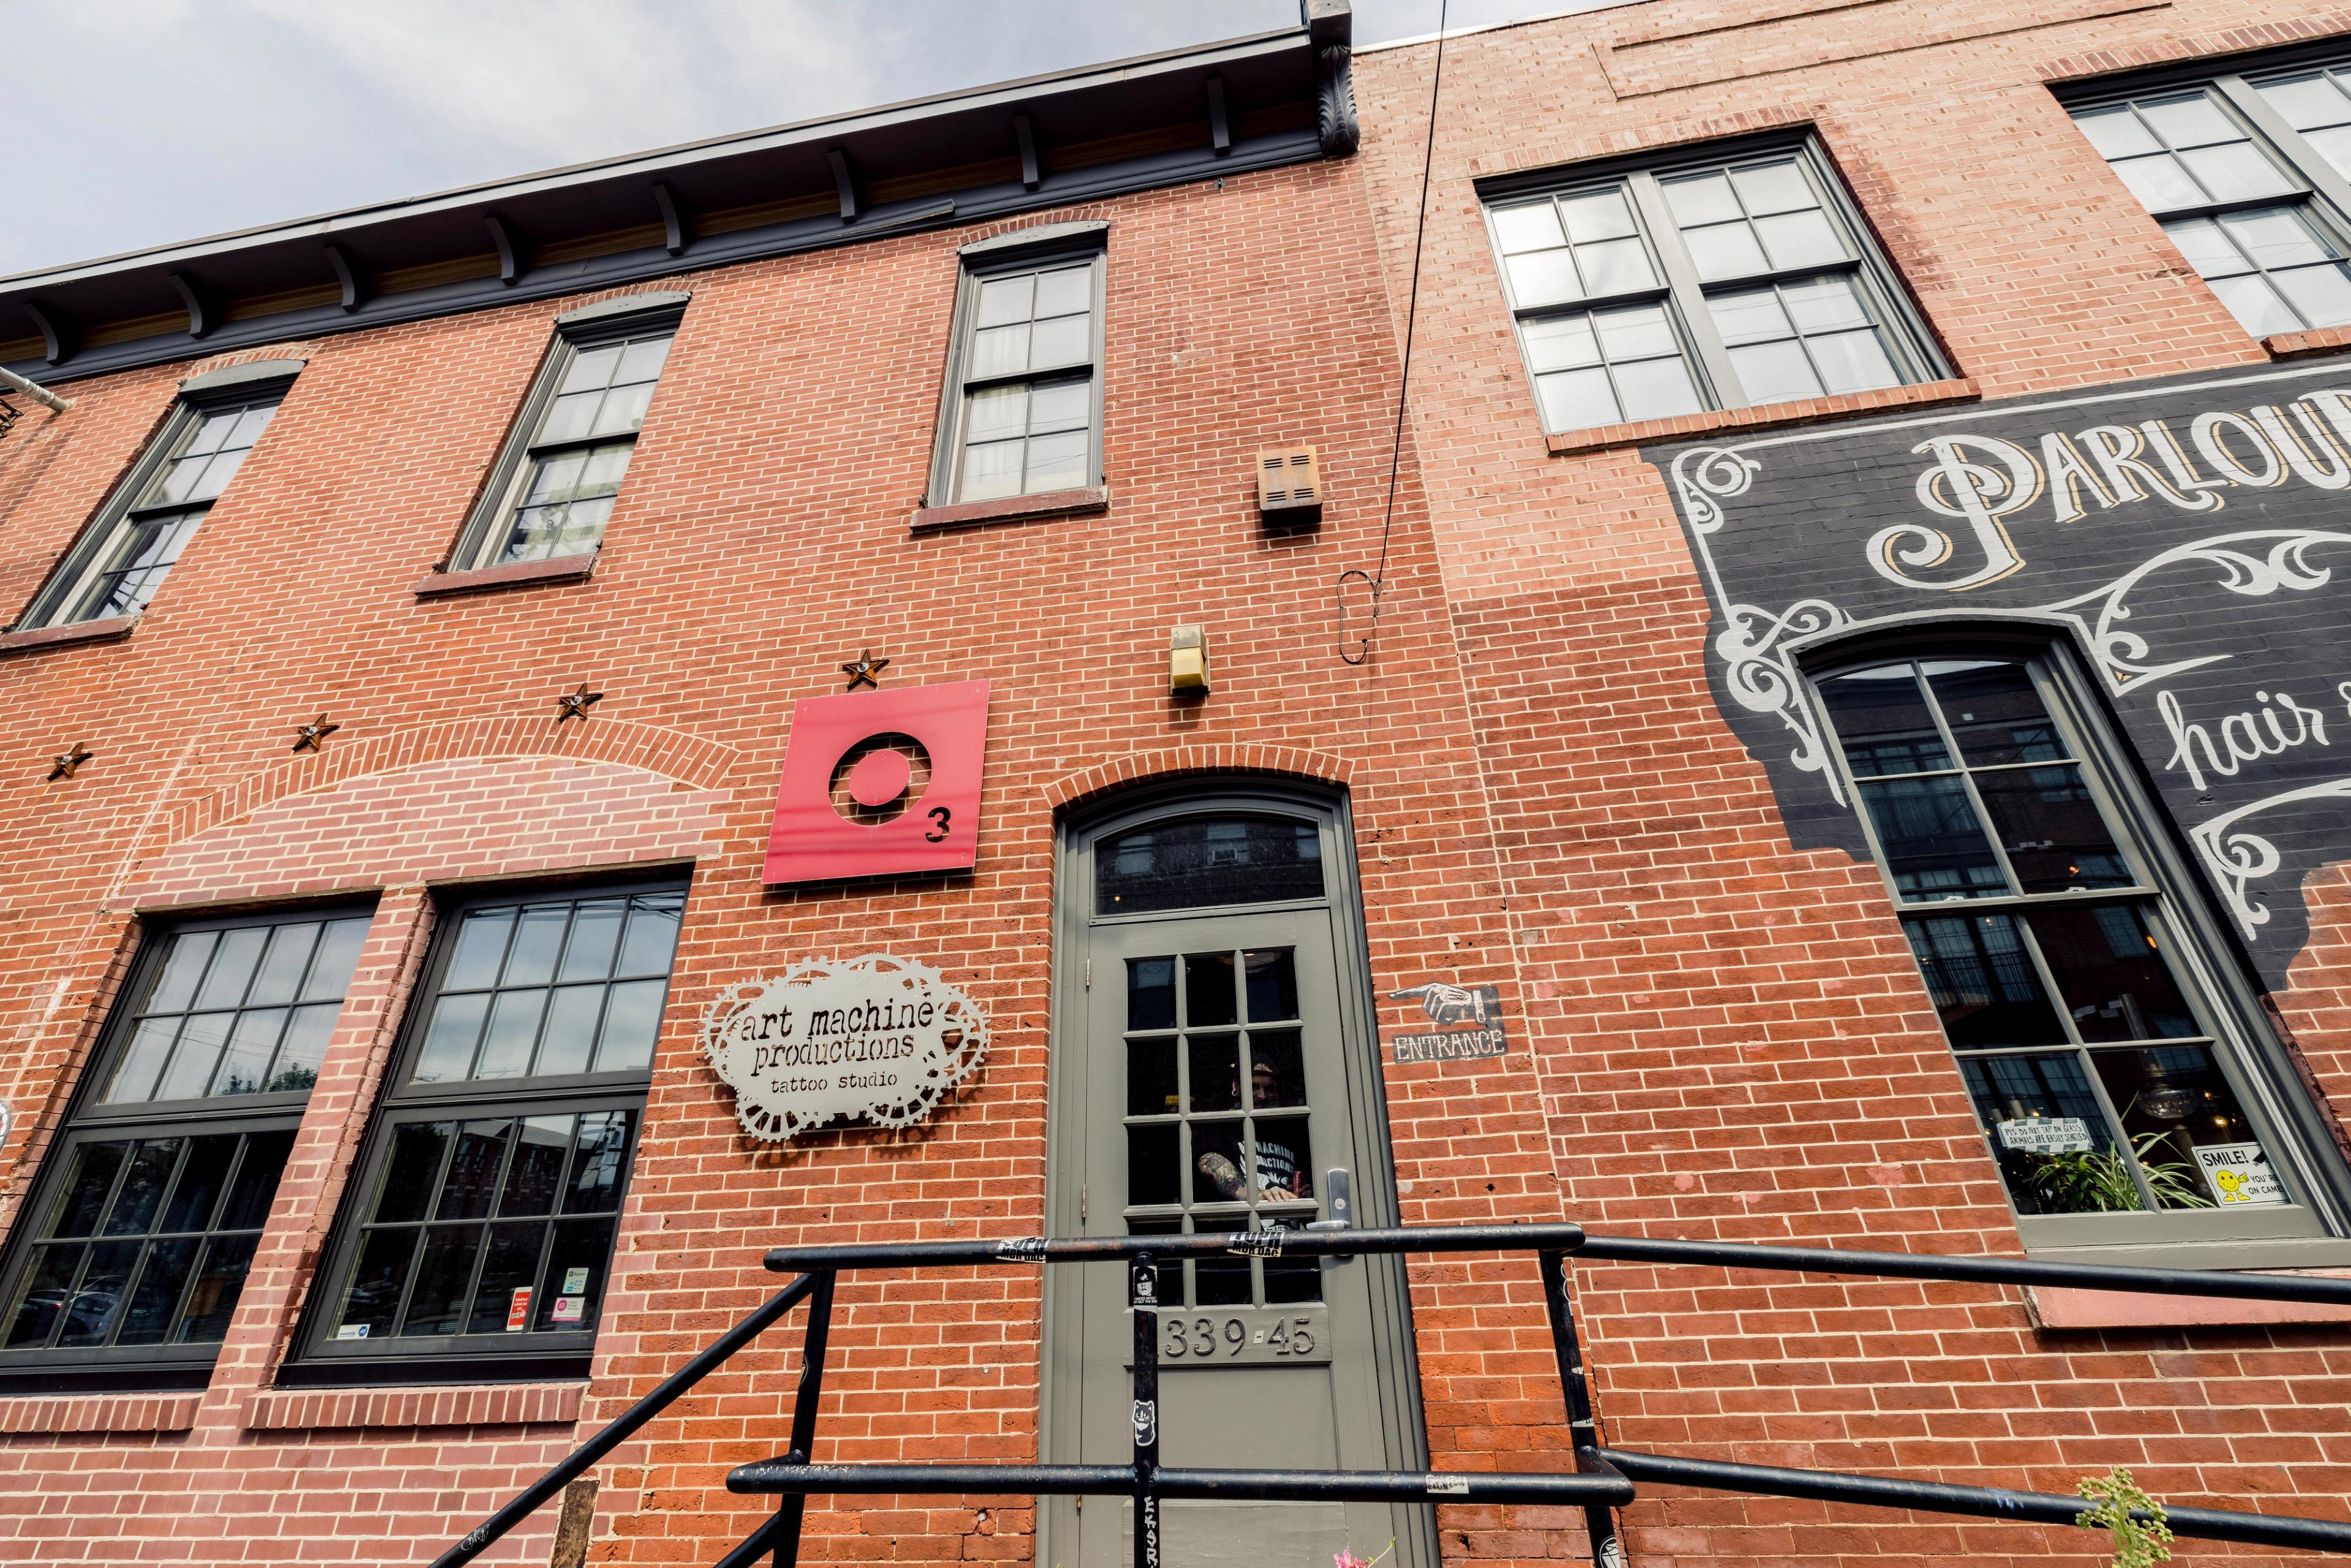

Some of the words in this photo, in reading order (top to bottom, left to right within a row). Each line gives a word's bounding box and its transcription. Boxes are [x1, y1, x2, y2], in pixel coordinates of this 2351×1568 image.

[2157, 690, 2330, 790] hair
[741, 1004, 792, 1041] art
[808, 998, 934, 1036] machine
[1394, 1030, 1505, 1060] ENTRANCE
[750, 1033, 914, 1077] productions
[771, 1076, 828, 1093] tattoo
[838, 1071, 898, 1089] studio
[2063, 1124, 2082, 1133] GLASS
[2009, 1136, 2034, 1145] ANIMALS
[2035, 1135, 2047, 1143] ARE
[2047, 1134, 2064, 1142] EASILY
[2202, 1150, 2249, 1166] SMILE!
[2250, 1174, 2279, 1183] YOU'RE
[2262, 1185, 2283, 1194] CAME
